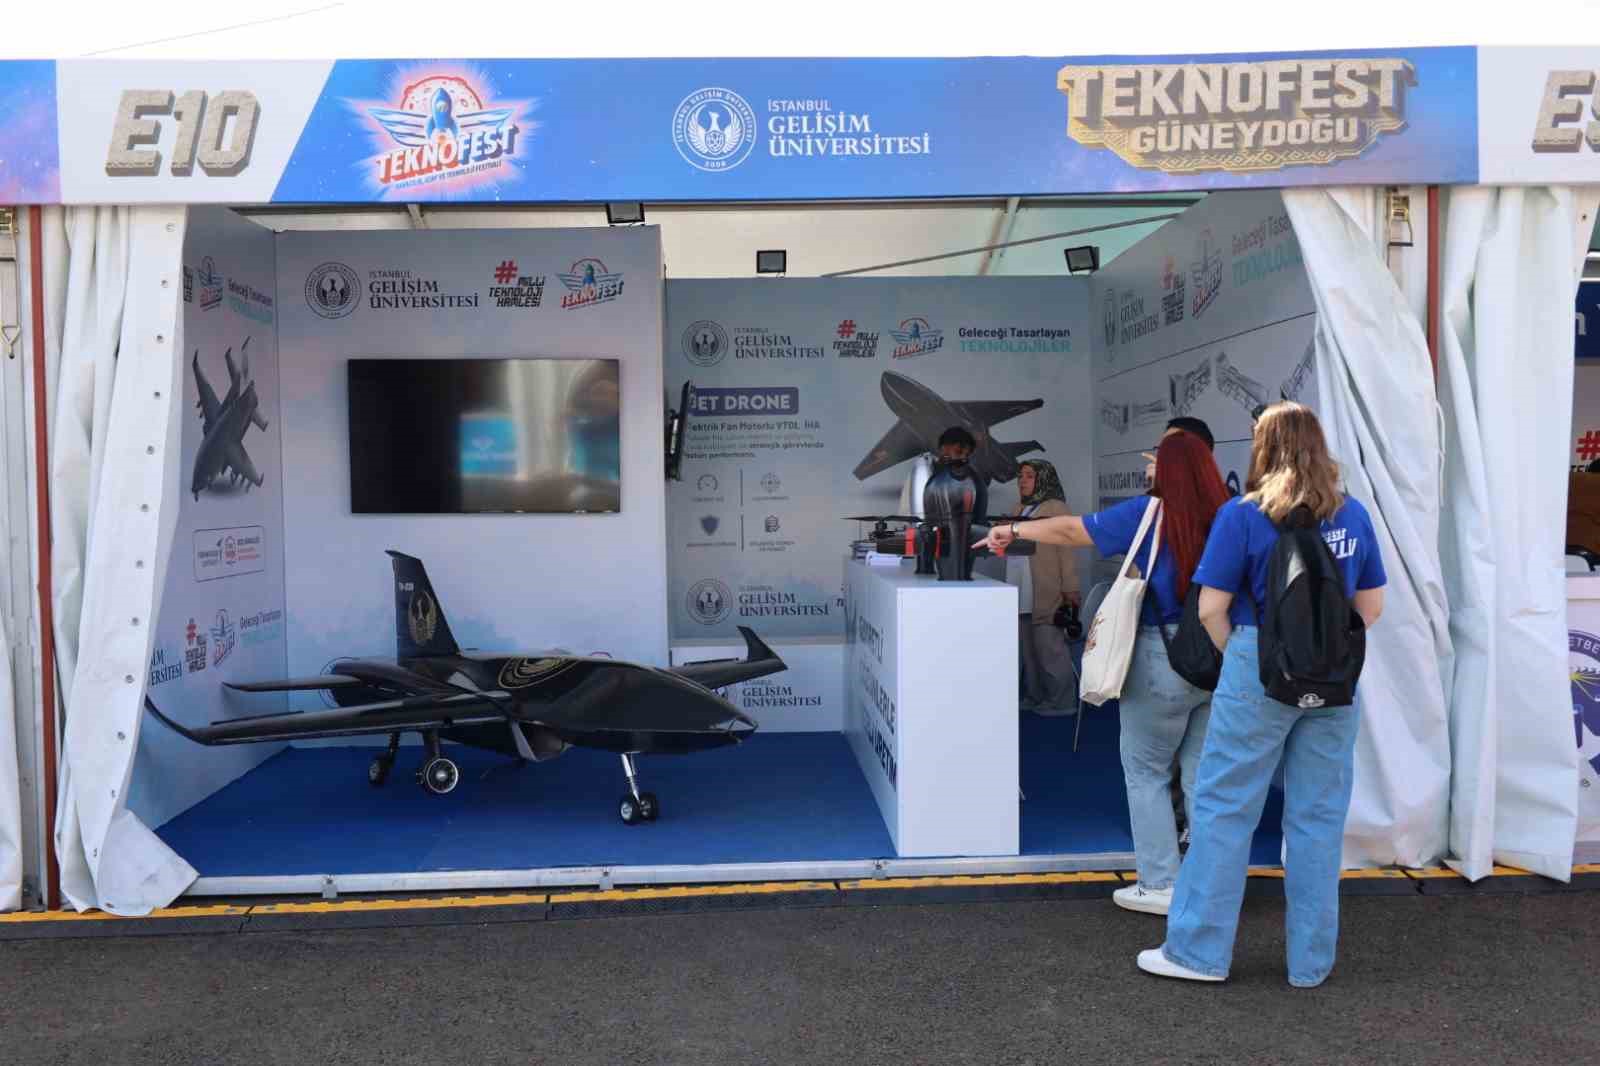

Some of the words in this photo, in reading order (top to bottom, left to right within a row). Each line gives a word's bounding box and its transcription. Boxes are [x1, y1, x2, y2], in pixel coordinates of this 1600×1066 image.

[1060, 59, 1408, 122] TEKNOFEST
[767, 98, 832, 112] İSTANBUL
[105, 89, 261, 177] E10
[767, 111, 871, 137] GELİŞİM
[1133, 115, 1359, 154] GÜNEYDOĞU
[376, 122, 520, 184] TEKNOFEST
[768, 132, 931, 157] ÜNİVERSİTESİ
[369, 278, 438, 295] GELİŞİM
[370, 293, 479, 309] ÜNİVERSİTESİ
[959, 327, 1007, 339] Geleceği
[1009, 327, 1071, 339] Tasarlayan
[724, 394, 791, 411] DRONE
